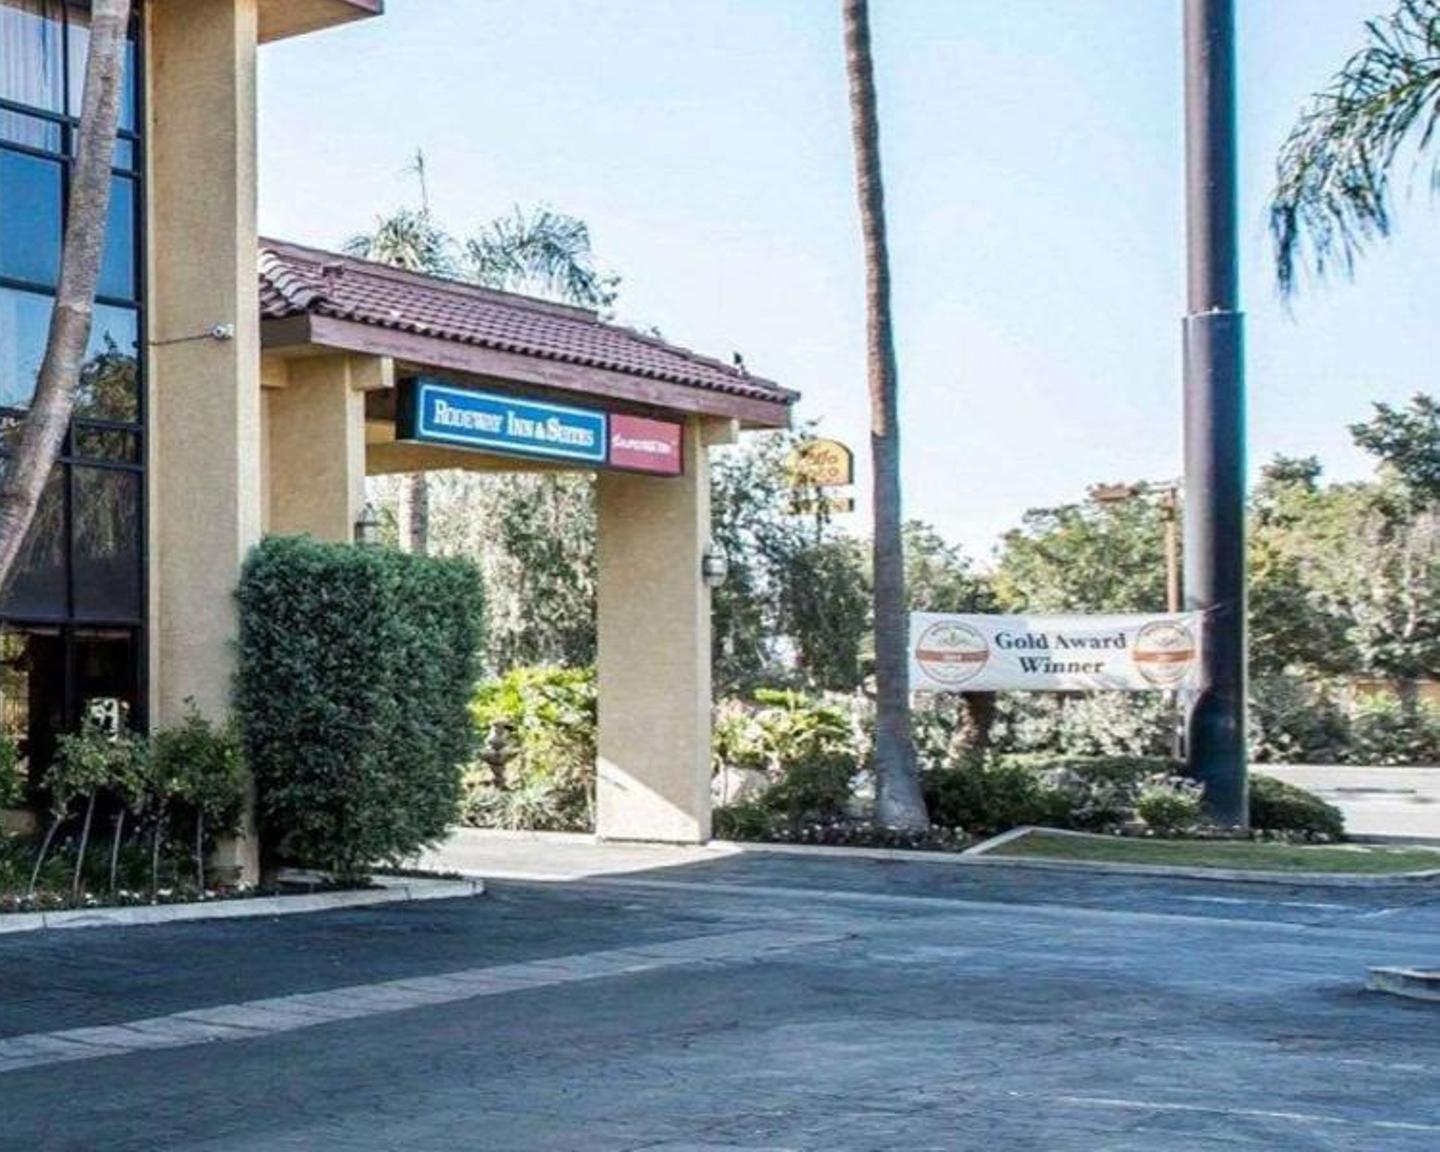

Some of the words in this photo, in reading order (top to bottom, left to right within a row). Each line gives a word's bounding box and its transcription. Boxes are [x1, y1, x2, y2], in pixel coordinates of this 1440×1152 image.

[433, 399, 503, 433] RODEWAY
[994, 632, 1049, 650] Gold
[1054, 632, 1127, 650] Award
[1018, 656, 1105, 675] Winner
